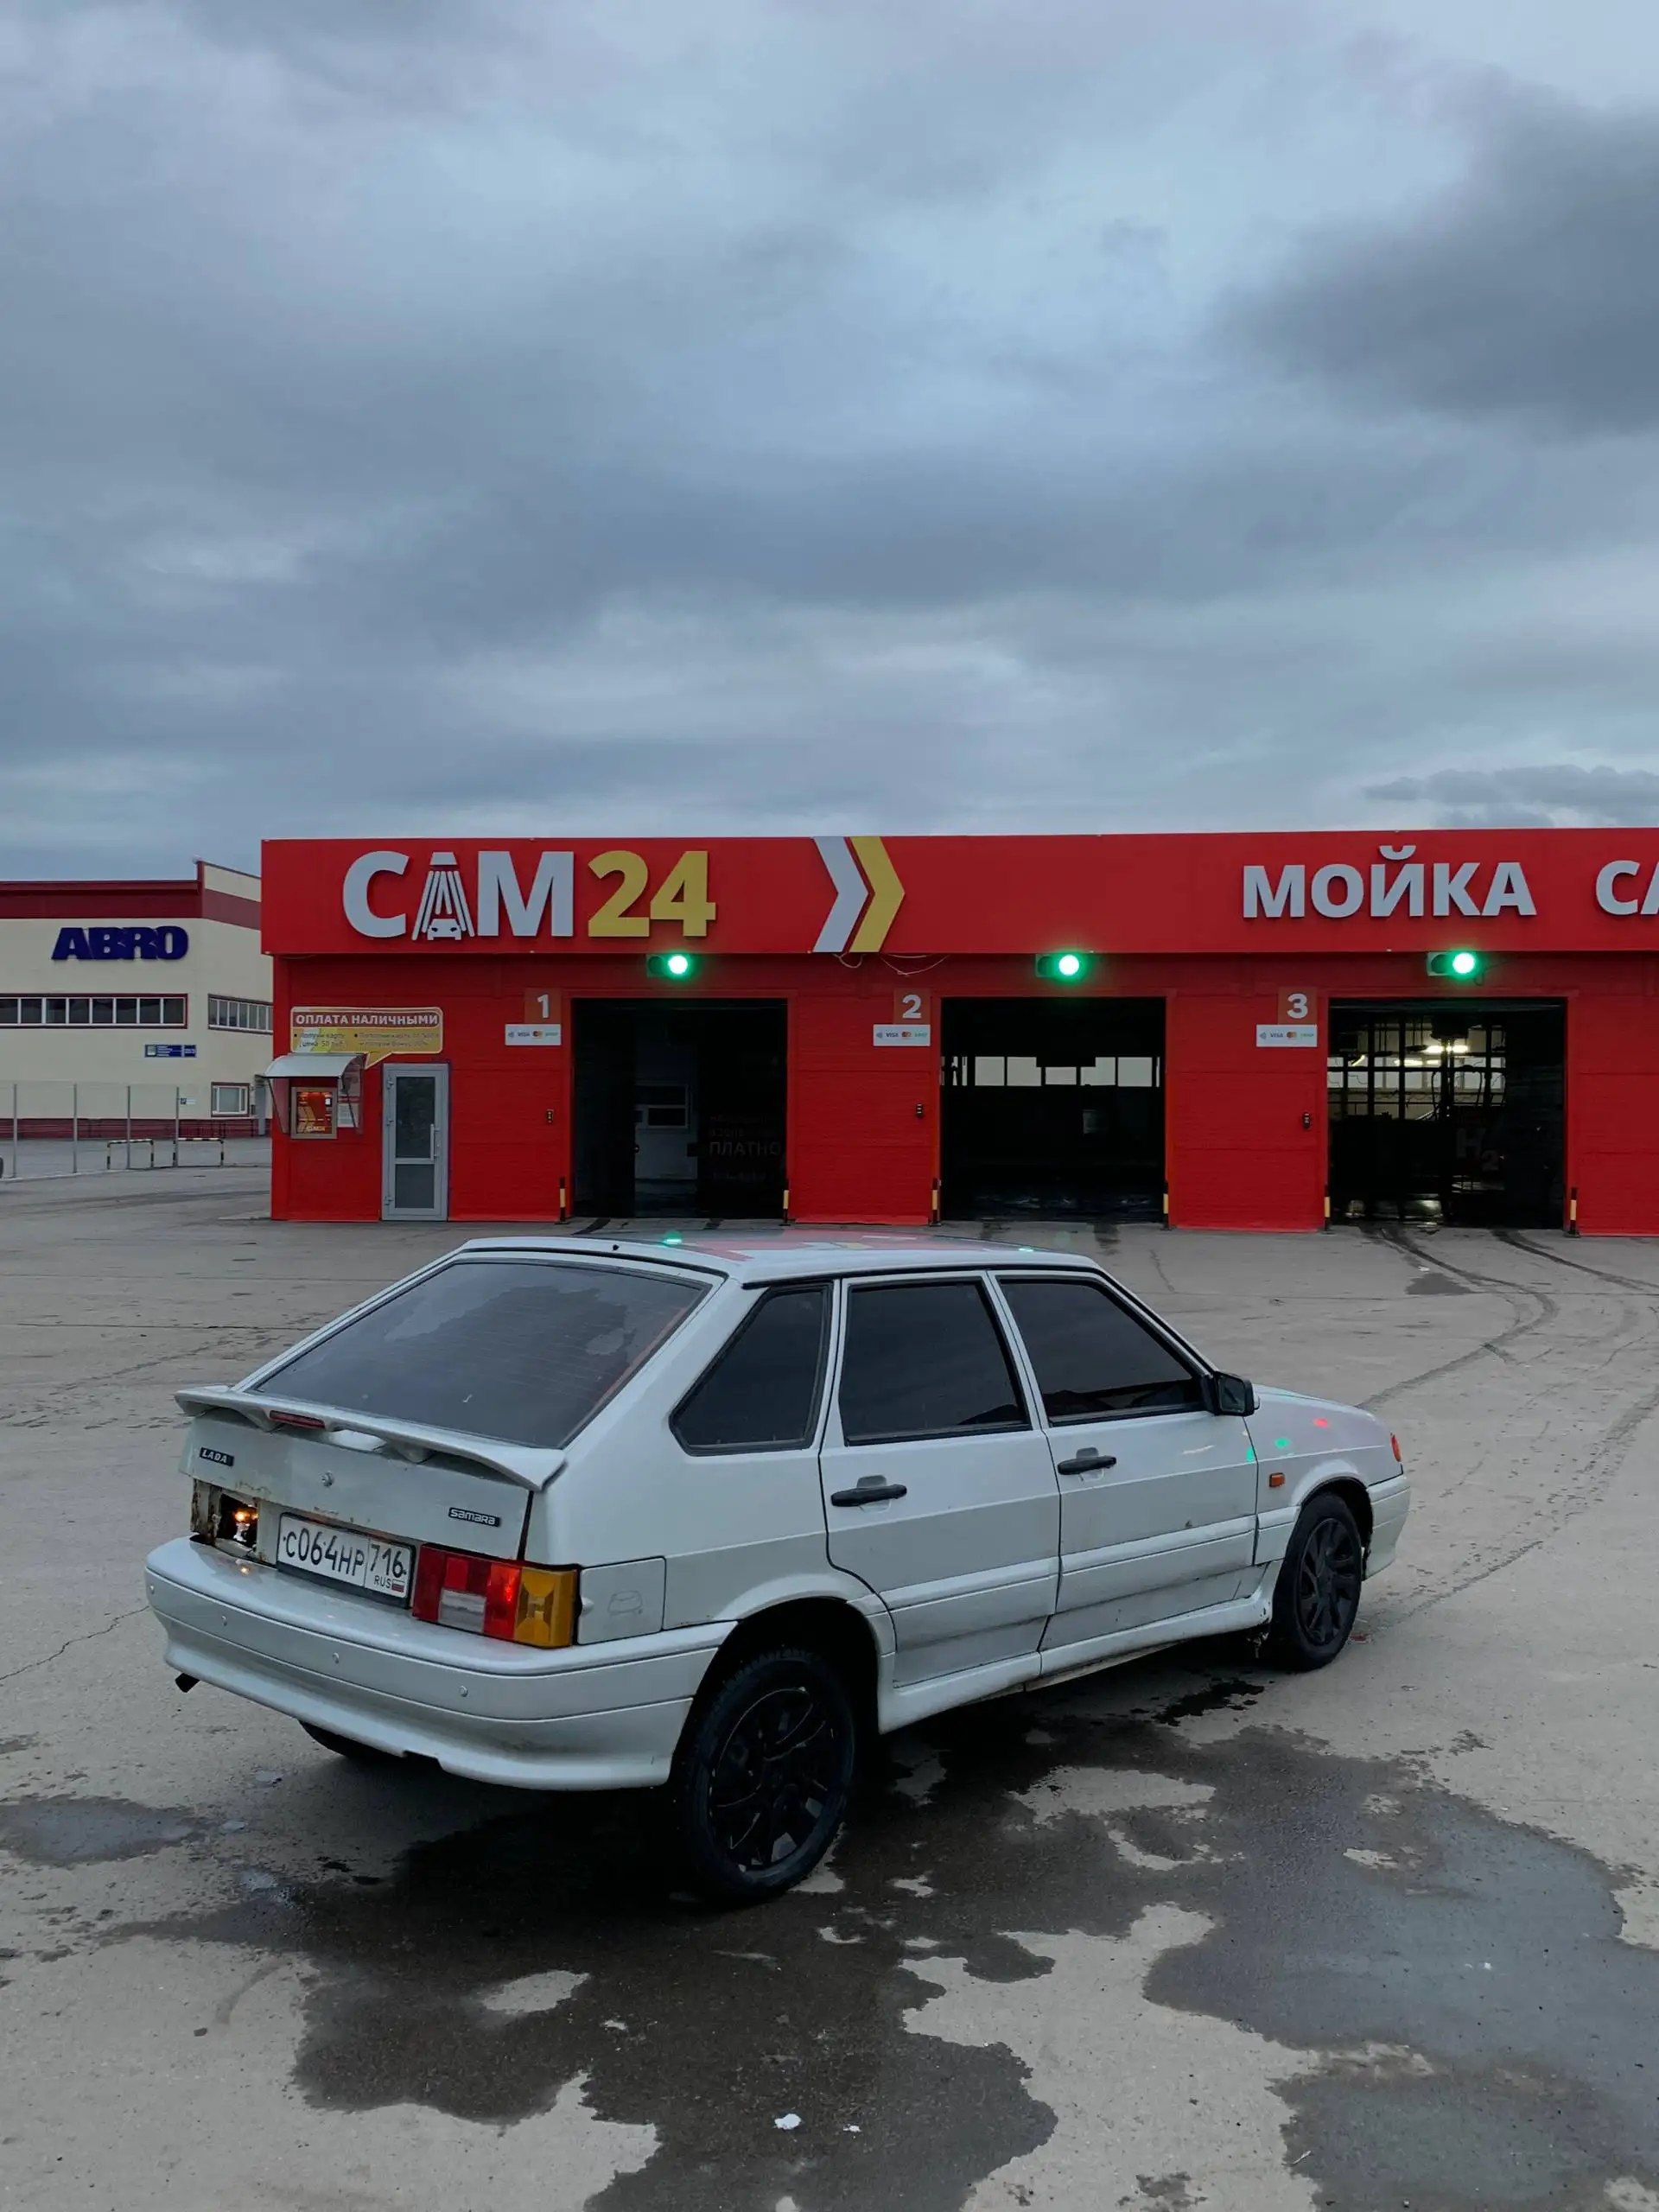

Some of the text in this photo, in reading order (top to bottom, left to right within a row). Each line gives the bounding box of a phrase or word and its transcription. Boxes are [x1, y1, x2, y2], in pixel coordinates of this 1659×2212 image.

[1243, 844, 1538, 918] МОЙКА
[51, 925, 189, 961] ABRO
[537, 994, 550, 1019] 1
[901, 994, 922, 1019] 2
[1287, 993, 1309, 1019] 3
[296, 1014, 439, 1026] ОПЛАТА НАЛИЧНЫМИ
[201, 1449, 228, 1464] LADA
[370, 1543, 406, 1579] 716
[373, 1574, 392, 1589] RUS
